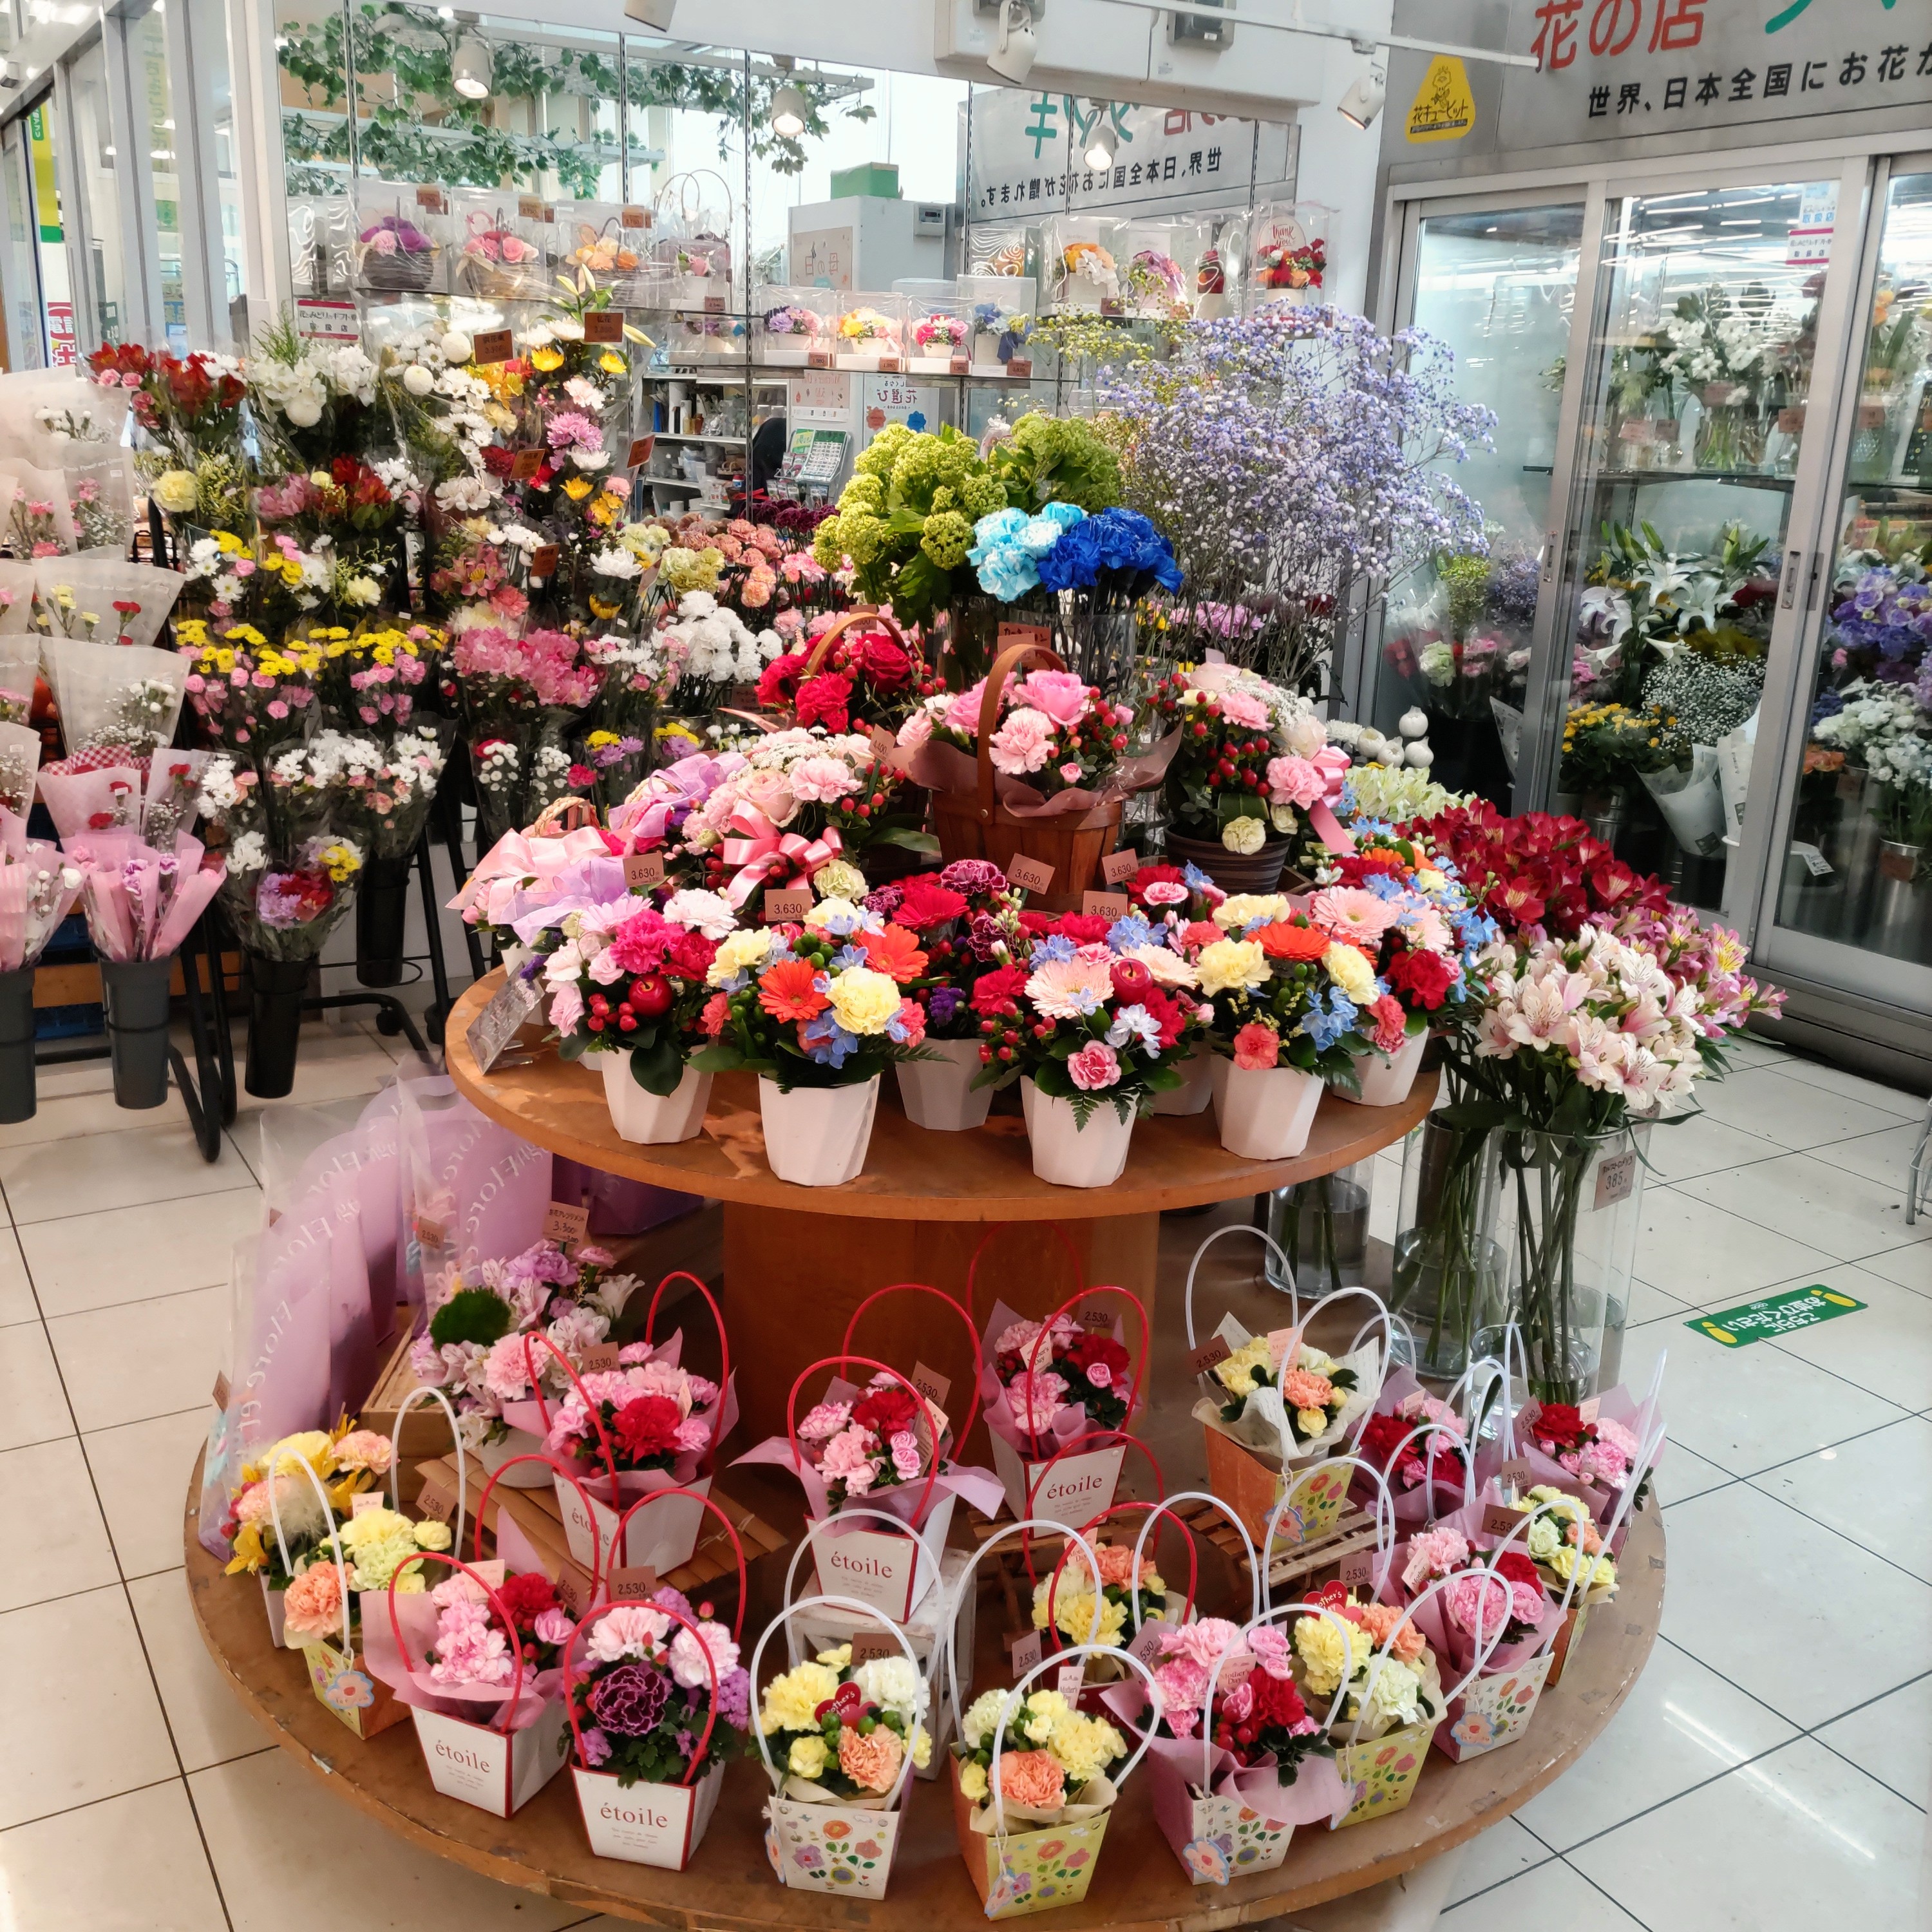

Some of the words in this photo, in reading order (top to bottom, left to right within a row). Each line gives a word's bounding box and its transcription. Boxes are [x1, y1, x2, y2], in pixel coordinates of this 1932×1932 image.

[1530, 0, 1706, 73] 花の店
[1605, 1171, 1624, 1190] 385
[1721, 1296, 1827, 1332] お並びください
[1763, 1312, 1821, 1333] こちらに
[1047, 1475, 1103, 1499] étoile
[571, 1508, 610, 1546] étole
[831, 1551, 893, 1578] étoile
[435, 1739, 491, 1774] étoile
[600, 1802, 668, 1828] étoile
